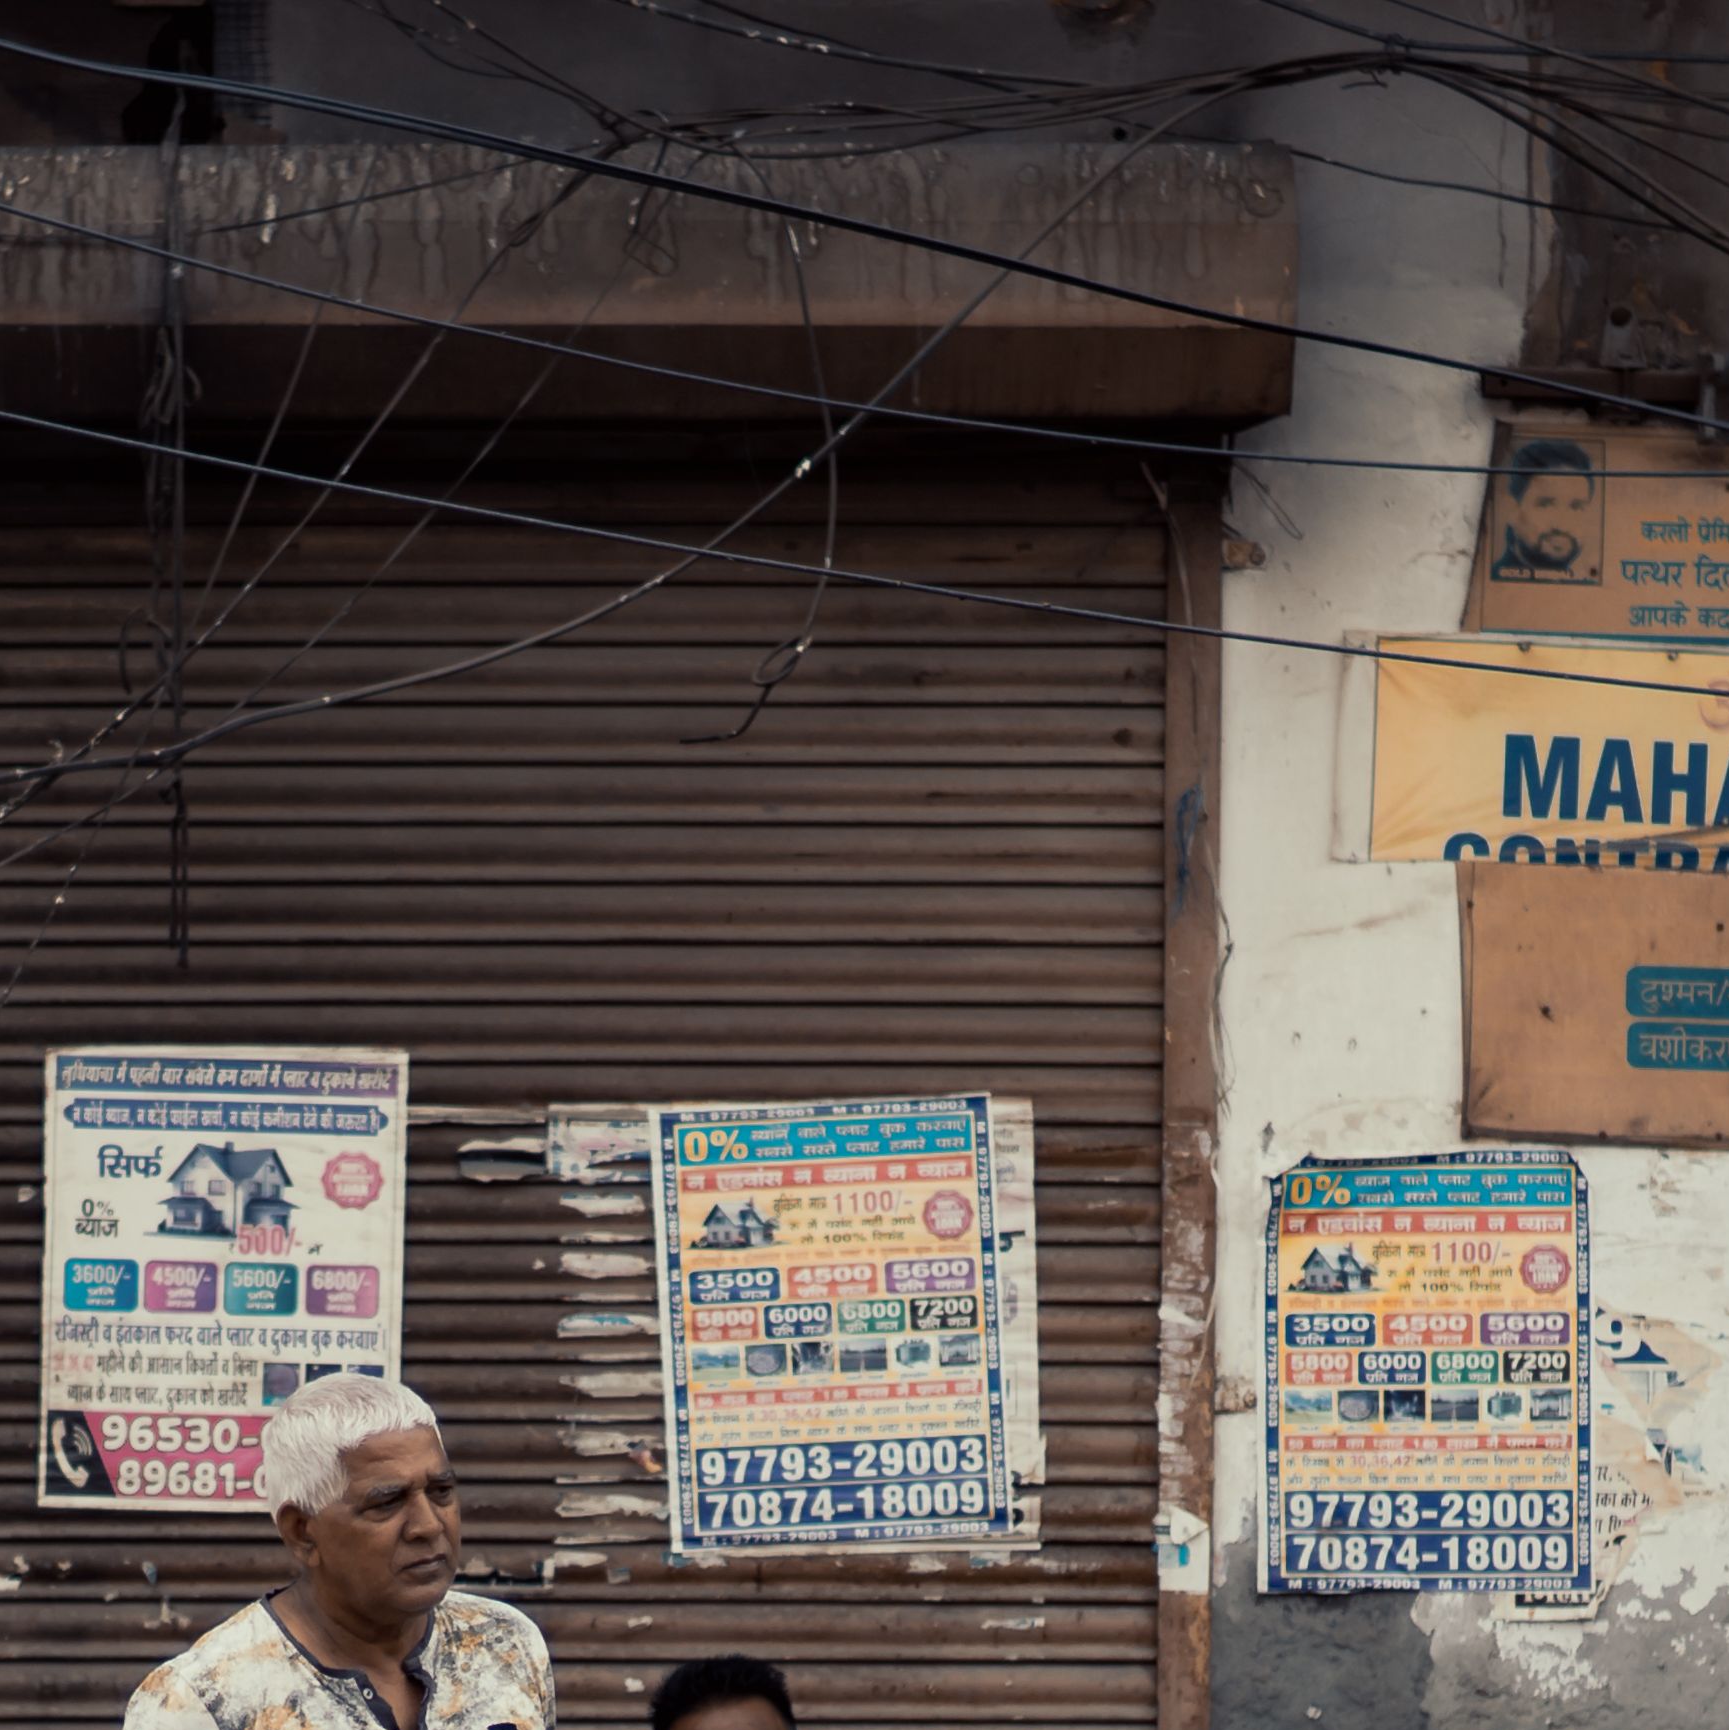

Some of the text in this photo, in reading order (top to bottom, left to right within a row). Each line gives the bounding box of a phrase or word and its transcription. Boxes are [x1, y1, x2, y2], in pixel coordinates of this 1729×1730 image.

[1641, 517, 1690, 544] करलो
[1620, 559, 1686, 587] पत्थर
[1629, 602, 1690, 628] आपके
[861, 1100, 967, 1113] 97793-29003
[683, 1128, 748, 1162] 0%
[935, 1136, 965, 1149] पास
[97, 1143, 164, 1179] सिर्फ
[1465, 1152, 1569, 1164] 97793-29003
[1290, 1175, 1351, 1206] 0%
[1537, 1191, 1566, 1203] पास
[81, 1198, 114, 1217] 0%
[832, 1190, 913, 1214] 1100/-
[75, 1217, 120, 1238] ब्याज
[237, 1224, 303, 1255] 500/-
[1431, 1242, 1511, 1264] 1100/-
[72, 1264, 131, 1285] 3600/-
[232, 1268, 291, 1289] 5600/-
[696, 1271, 774, 1289] 3500
[793, 1266, 872, 1285] 4500
[892, 1261, 970, 1279] 5600
[769, 1306, 828, 1324] 6000
[914, 1298, 973, 1316] 7200
[1292, 1316, 1370, 1332] 3500
[1389, 1316, 1468, 1332] 4500
[1487, 1314, 1565, 1331] 5600
[54, 1315, 332, 1358] रजिस्ट्री इंतकाल फरद वाले प्लाट दुकान बुक
[97, 1350, 125, 1377] महीने
[146, 1356, 183, 1375] आसान
[233, 1353, 259, 1378] बिना
[1363, 1354, 1421, 1370] 6000
[1436, 1354, 1495, 1370] 6800
[1508, 1352, 1567, 1370] 7200
[109, 1384, 132, 1402] साथ
[165, 1385, 197, 1412] दुकान
[200, 1384, 215, 1405] को
[101, 1414, 269, 1454] 96530-
[700, 1437, 984, 1485] 97793-29003
[705, 1479, 984, 1529] 70874-18009
[1289, 1492, 1571, 1529] 97793-29003
[884, 1522, 989, 1538] 97793-29003
[1292, 1535, 1568, 1572] 70874-18009
[1317, 1579, 1420, 1589] 97793-29003
[1467, 1579, 1571, 1589] 97793-29003
